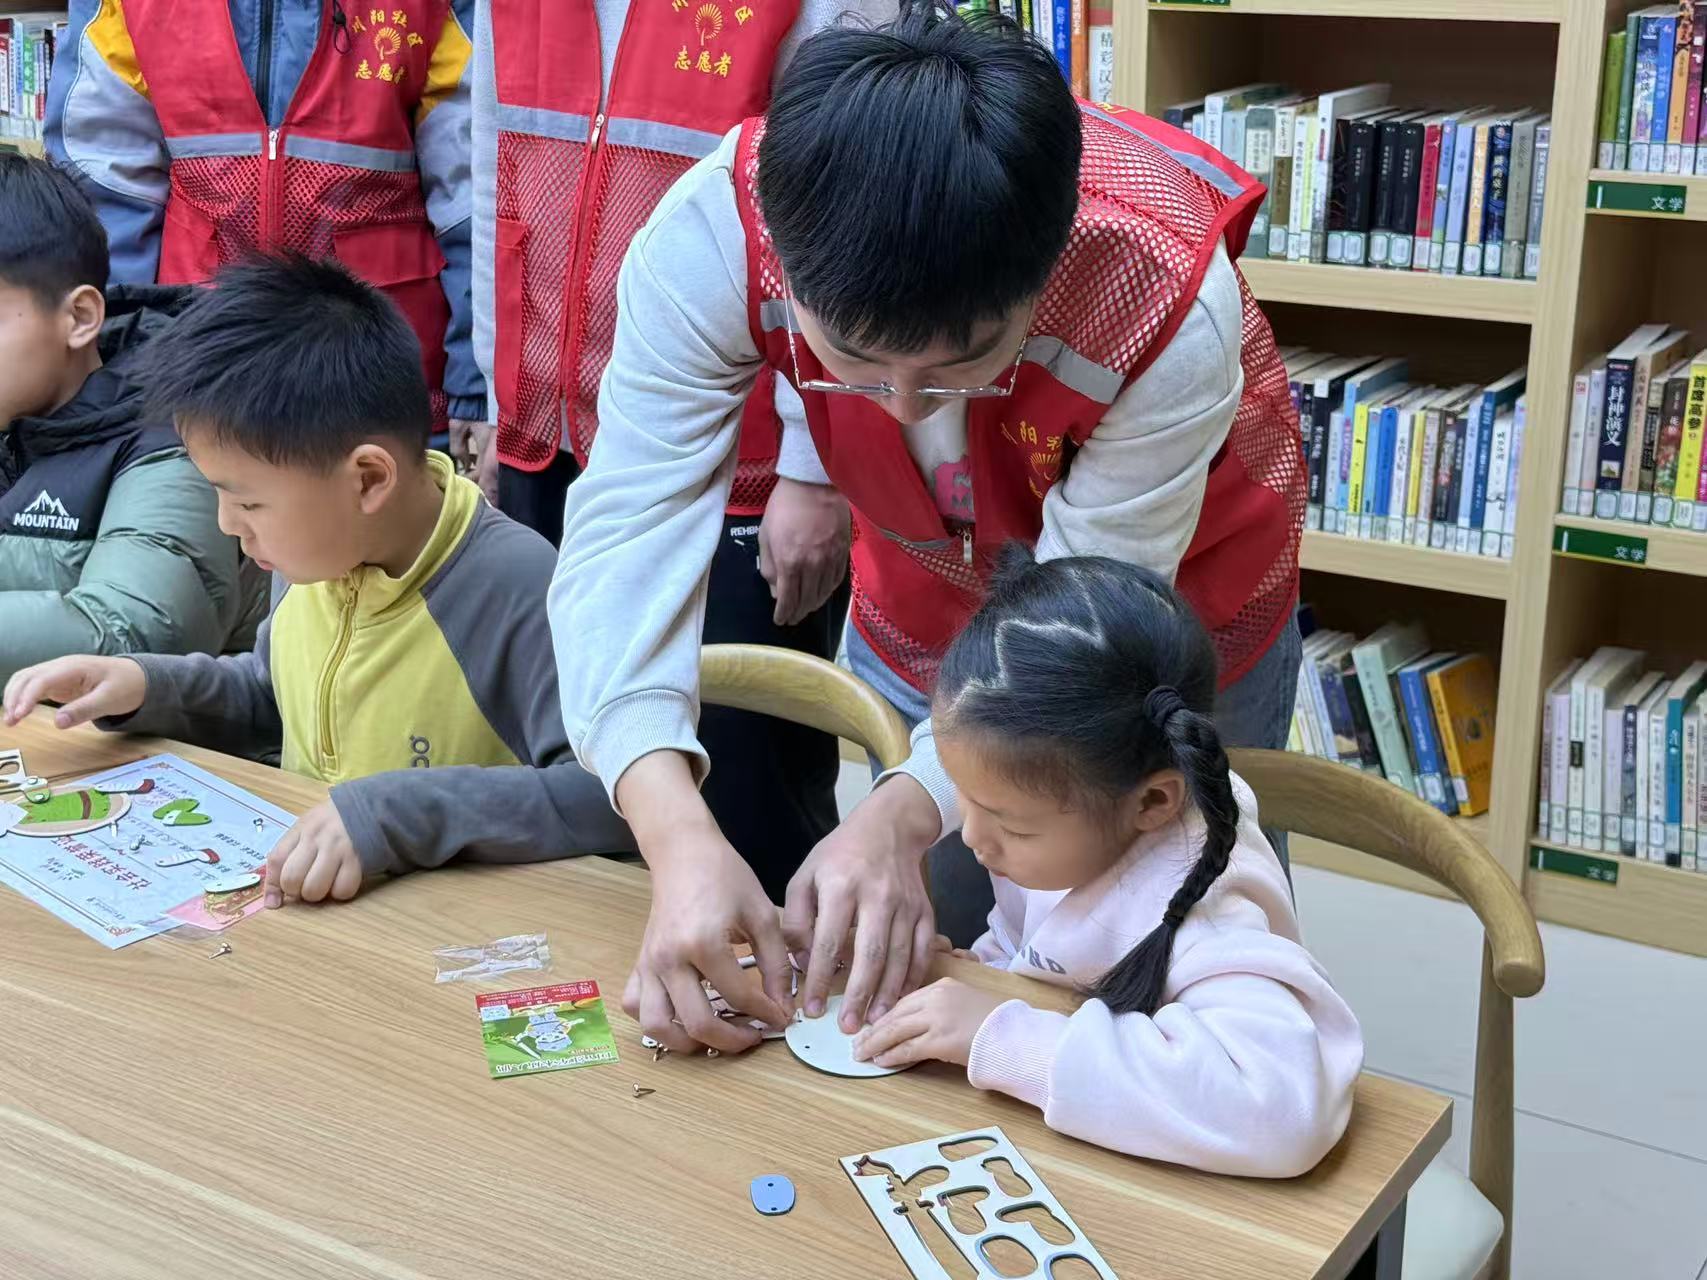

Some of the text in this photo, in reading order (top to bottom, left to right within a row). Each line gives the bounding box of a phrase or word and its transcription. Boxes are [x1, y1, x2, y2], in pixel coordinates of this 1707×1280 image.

[674, 45, 732, 78] 志愿者
[1651, 195, 1684, 212] 文学
[1600, 385, 1625, 447] 封神演义
[12, 512, 80, 531] MOUNTAIN
[1614, 544, 1645, 561] 文学
